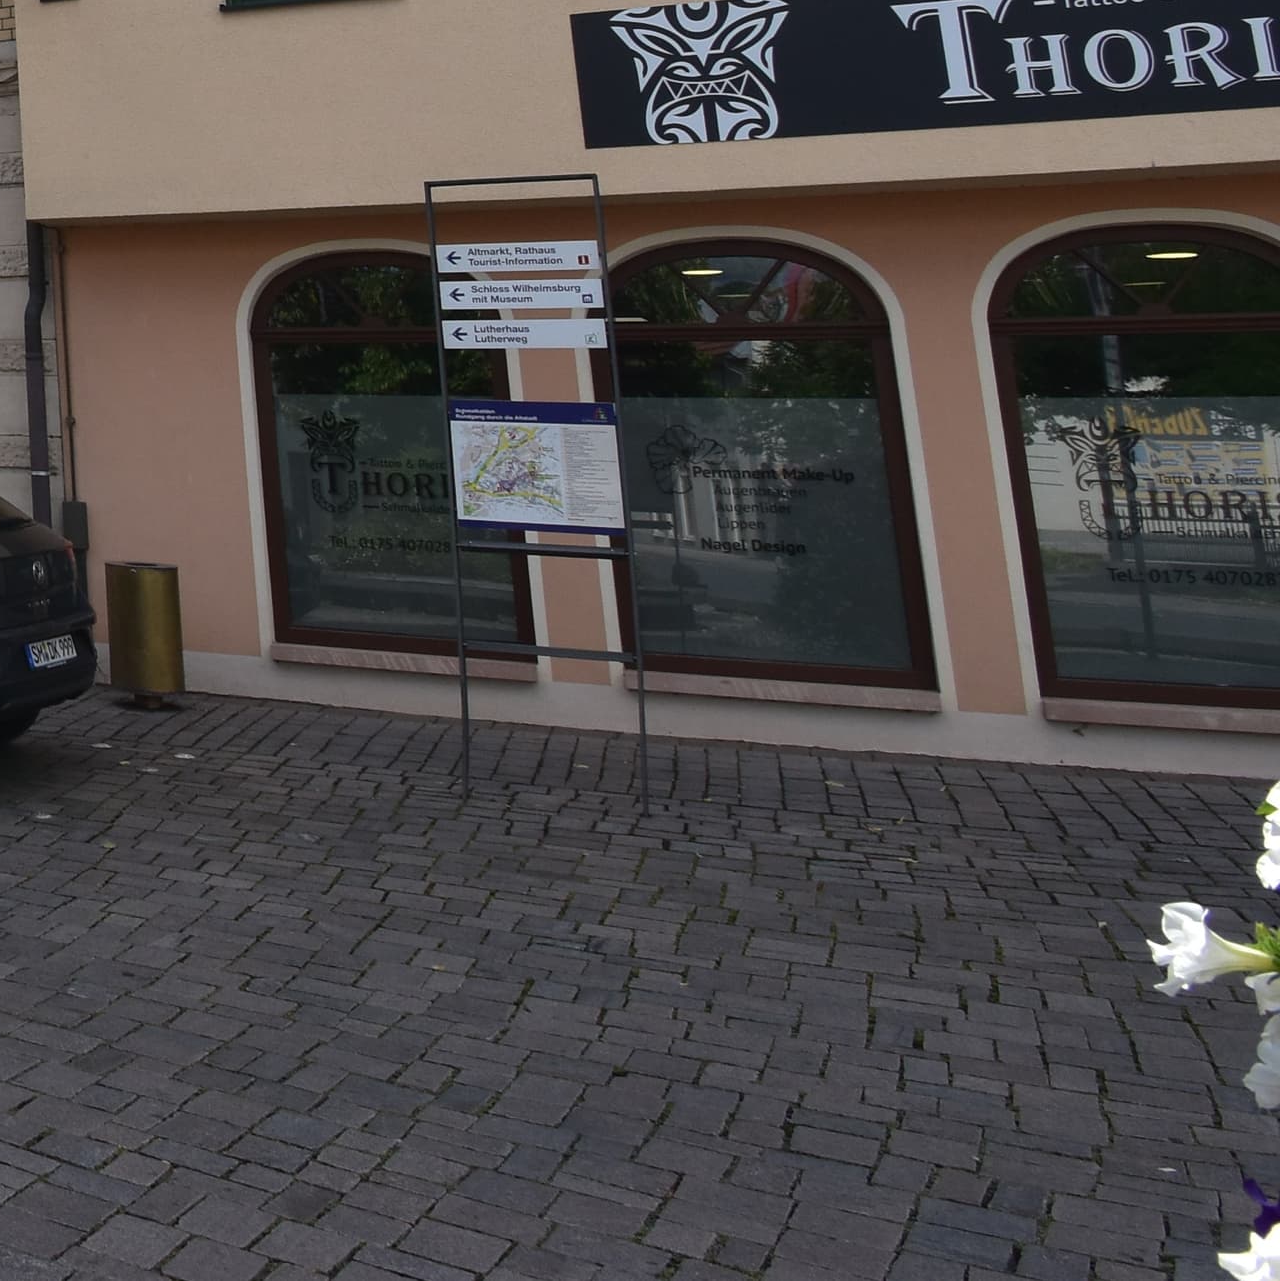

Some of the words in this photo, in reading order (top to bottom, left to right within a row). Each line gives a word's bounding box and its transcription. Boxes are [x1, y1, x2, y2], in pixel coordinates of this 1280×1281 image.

[468, 247, 512, 257] Altmarkt,
[515, 246, 556, 255] Rathaus
[468, 256, 563, 266] Tourist-Information
[471, 285, 509, 294] Schloss
[512, 284, 581, 293] Wilhelmsburg
[472, 295, 488, 303] mit
[491, 295, 533, 303] Museum
[474, 325, 530, 333] Lutherhaus
[475, 335, 528, 344] Lutherweg
[692, 466, 777, 480] Permanent
[783, 467, 855, 484] Make-Up
[1208, 473, 1220, 485] &
[719, 518, 766, 531] Lippen
[701, 537, 748, 553] Nagel
[752, 539, 807, 556] Design
[1149, 568, 1196, 584] 0175
[32, 644, 43, 664] SM
[46, 640, 60, 660] DK
[58, 637, 74, 657] 999
